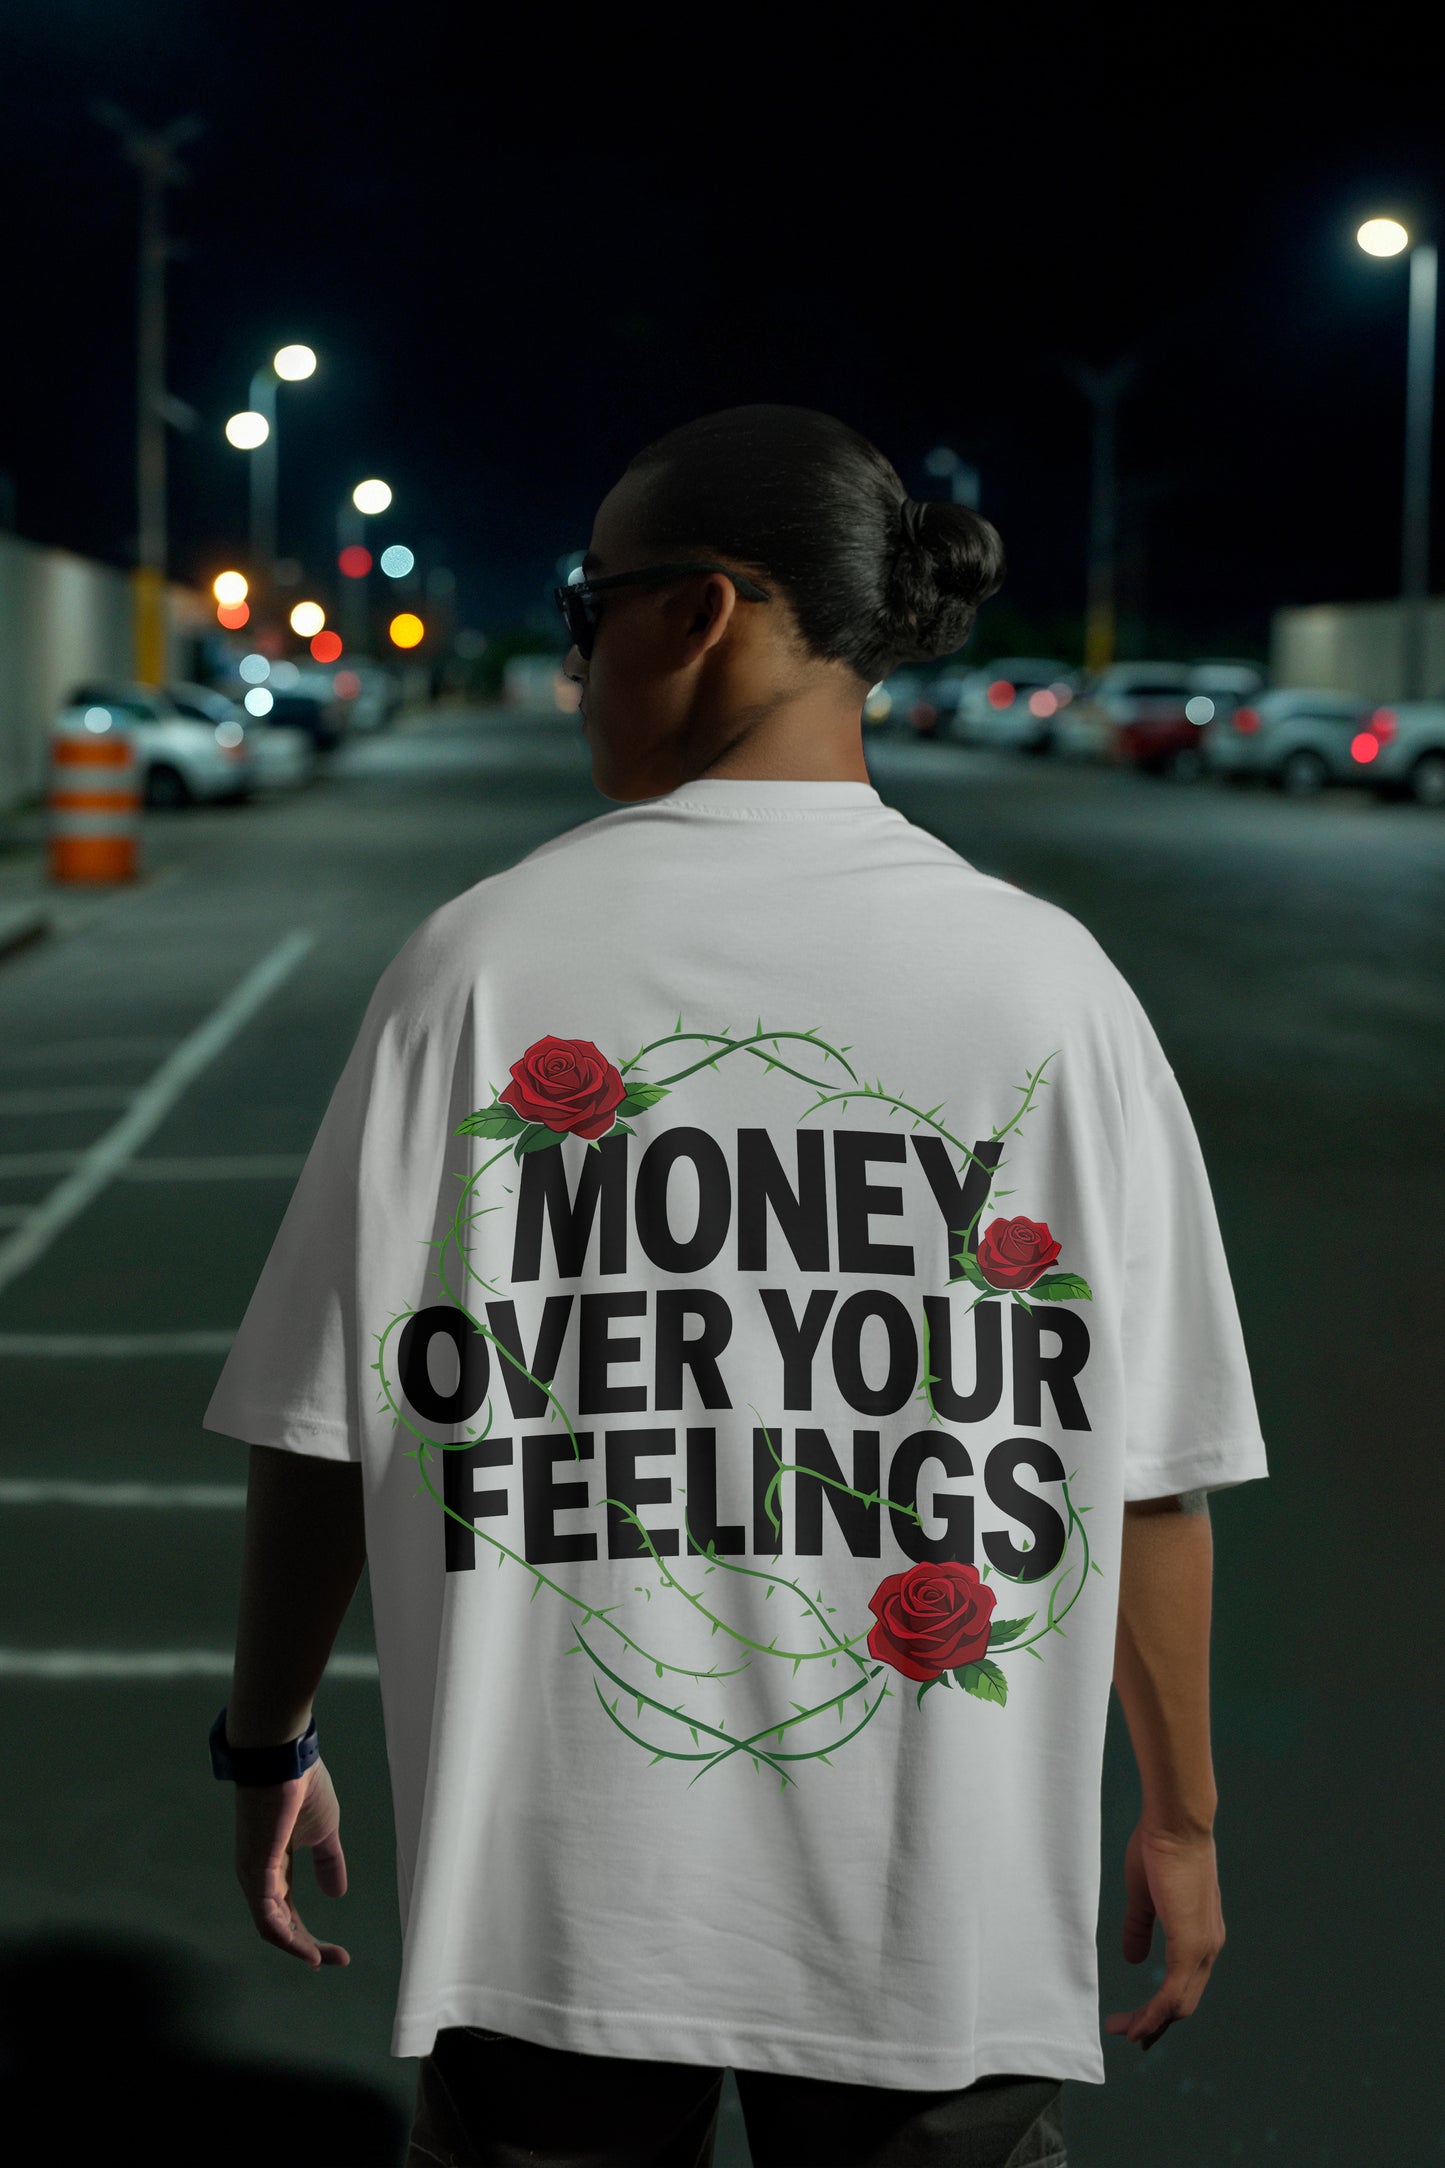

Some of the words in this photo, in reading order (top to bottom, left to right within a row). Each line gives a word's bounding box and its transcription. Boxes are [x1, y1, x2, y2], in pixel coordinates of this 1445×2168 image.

[511, 1126, 1004, 1282] MONEY
[397, 1289, 733, 1424] OVER
[758, 1288, 1092, 1431] YOUR
[442, 1427, 1066, 1581] FEELINGS
